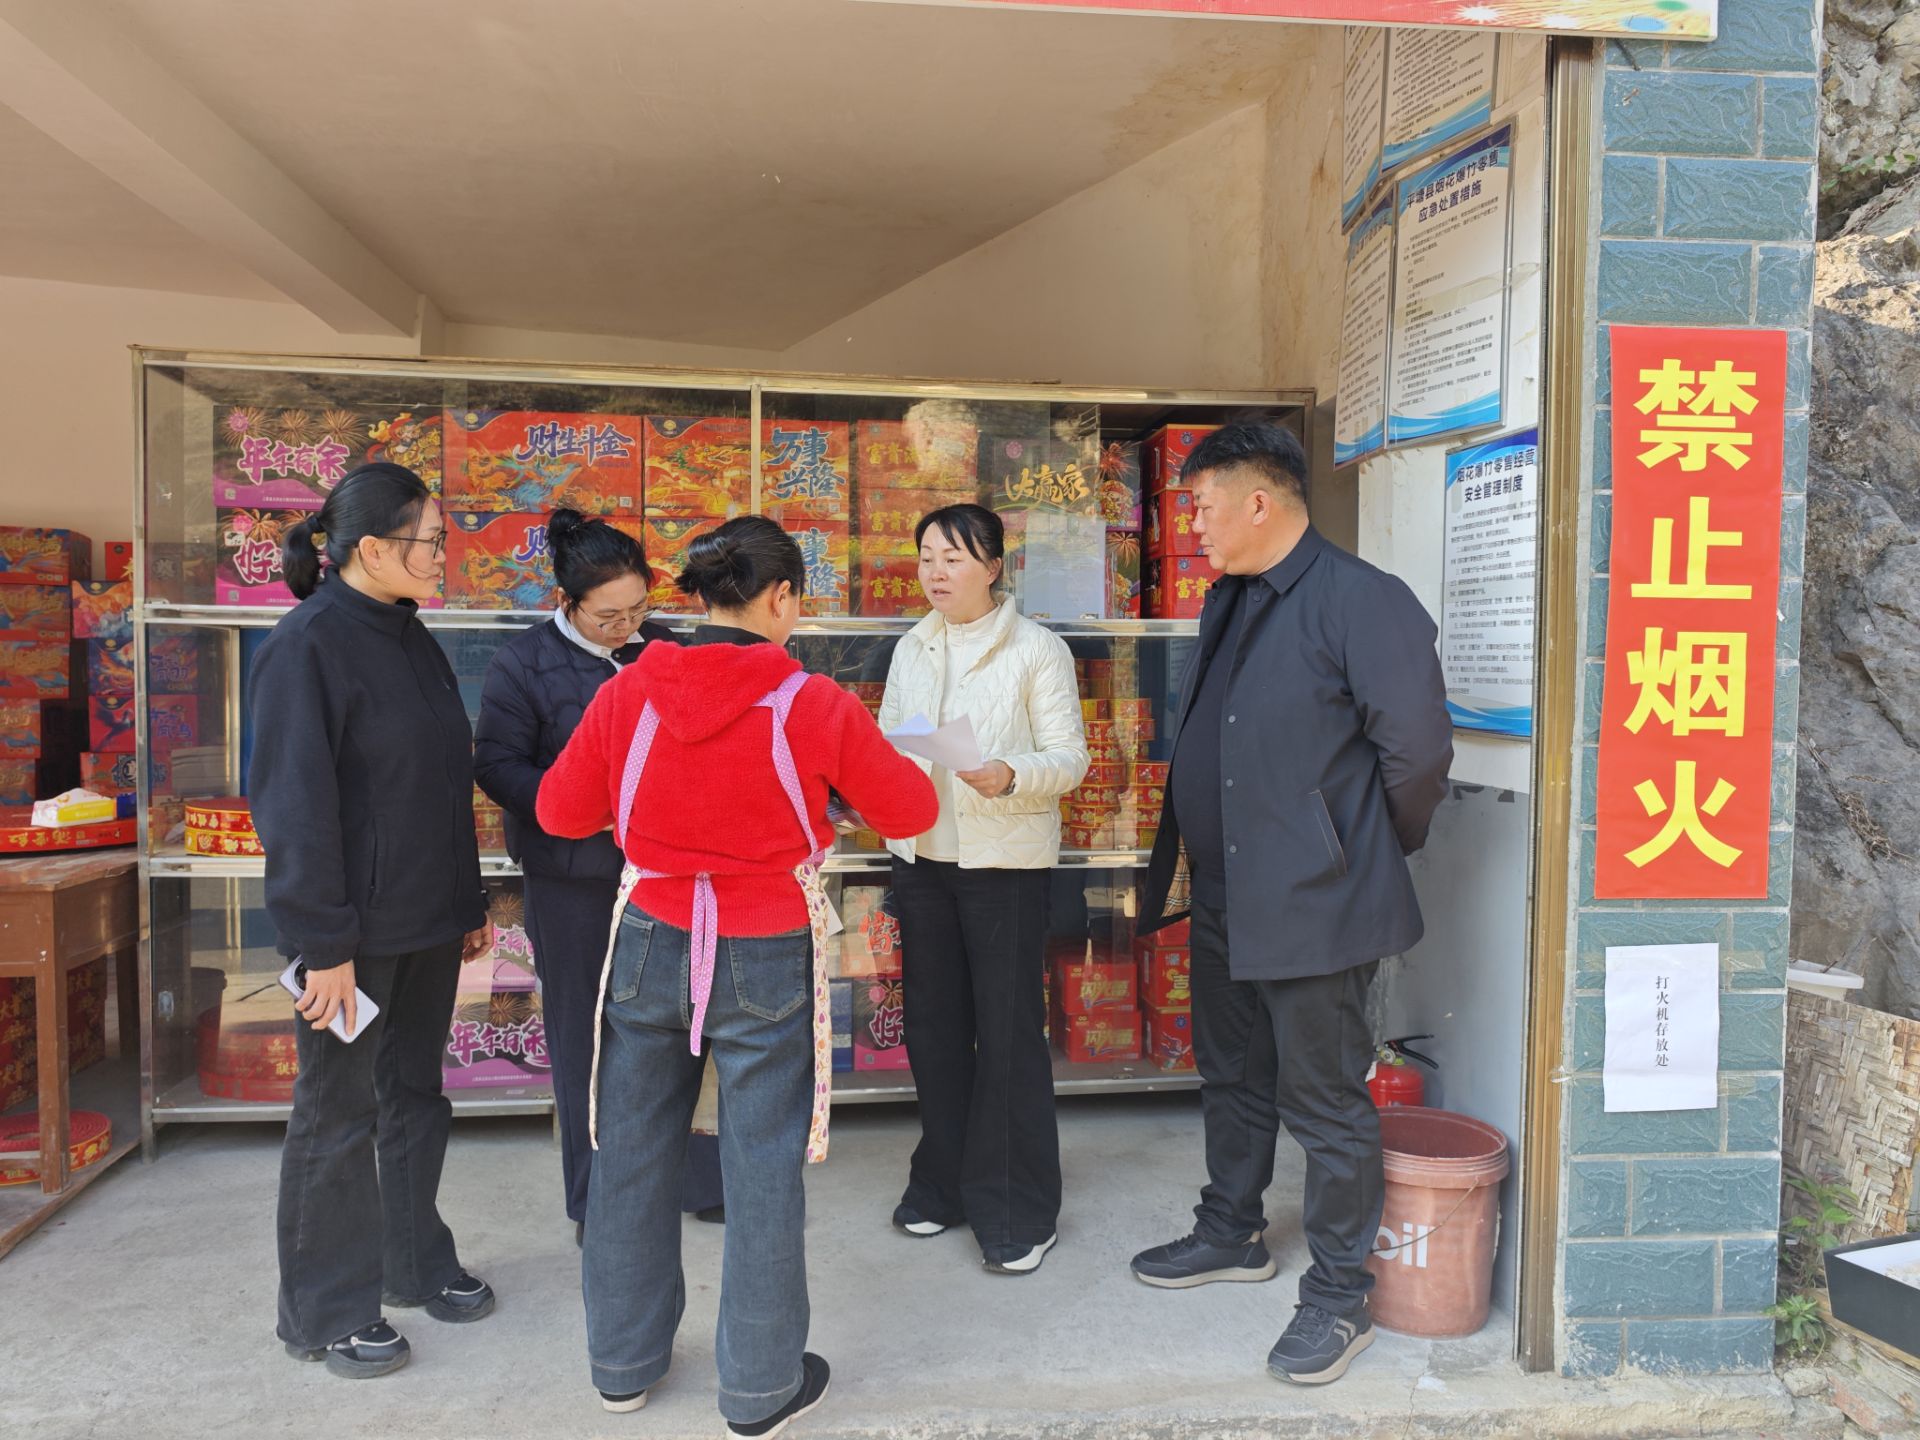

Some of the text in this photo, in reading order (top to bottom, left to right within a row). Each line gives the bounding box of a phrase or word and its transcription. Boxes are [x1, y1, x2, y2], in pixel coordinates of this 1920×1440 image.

[1407, 150, 1499, 208] 平塘县烟花爆竹零售
[1418, 180, 1482, 223] 应急处置措施
[1005, 463, 1090, 501] 大赢家
[1456, 448, 1535, 483] 烟花爆竹零售经营
[1464, 474, 1524, 503] 安全管理制度
[1623, 359, 1760, 869] 禁止烟火
[1655, 975, 1671, 1067] 打火机存放处
